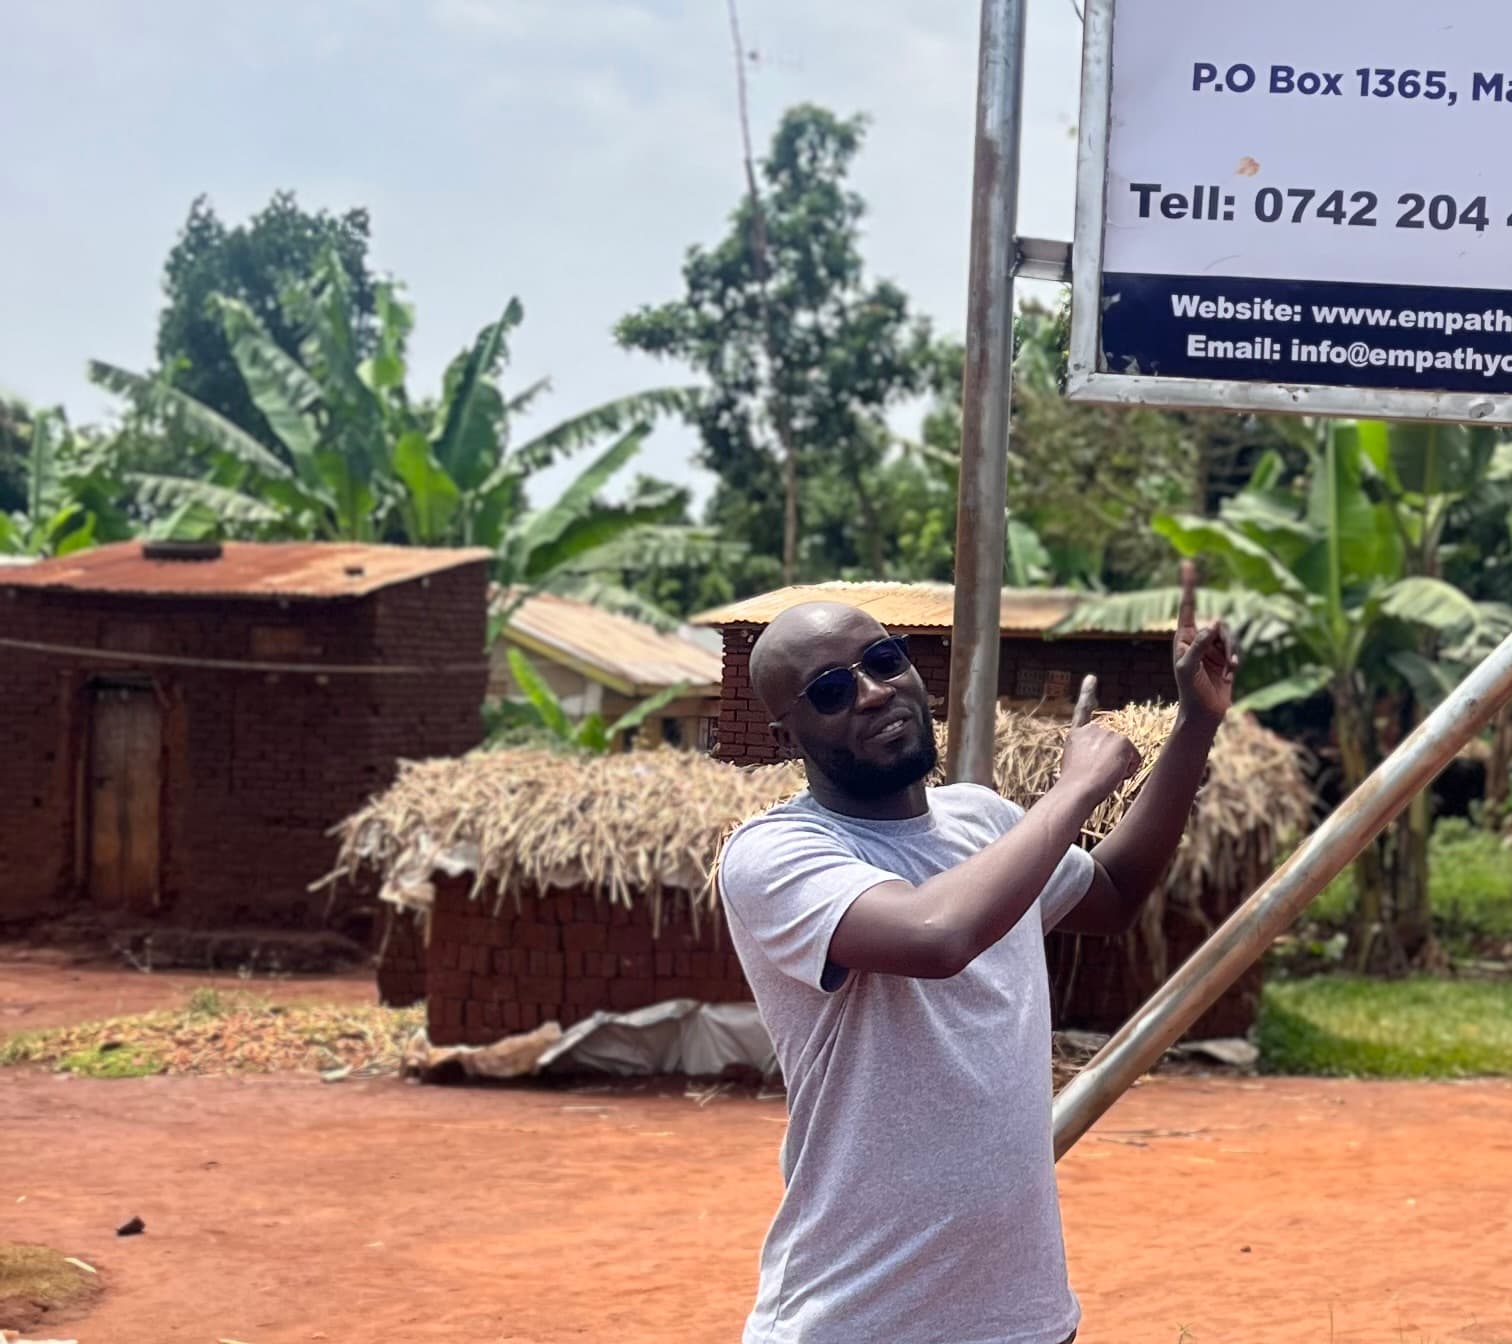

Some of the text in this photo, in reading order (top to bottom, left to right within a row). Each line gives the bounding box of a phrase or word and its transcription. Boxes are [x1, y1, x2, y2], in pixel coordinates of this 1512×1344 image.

[1193, 63, 1255, 92] P.O
[1270, 66, 1343, 95] Box
[1357, 68, 1457, 106] 1365,
[1130, 183, 1234, 220] Tell:
[1255, 188, 1377, 226] 0742
[1396, 193, 1489, 231] 204
[1172, 295, 1301, 321] Website:
[1188, 335, 1280, 360] Email:
